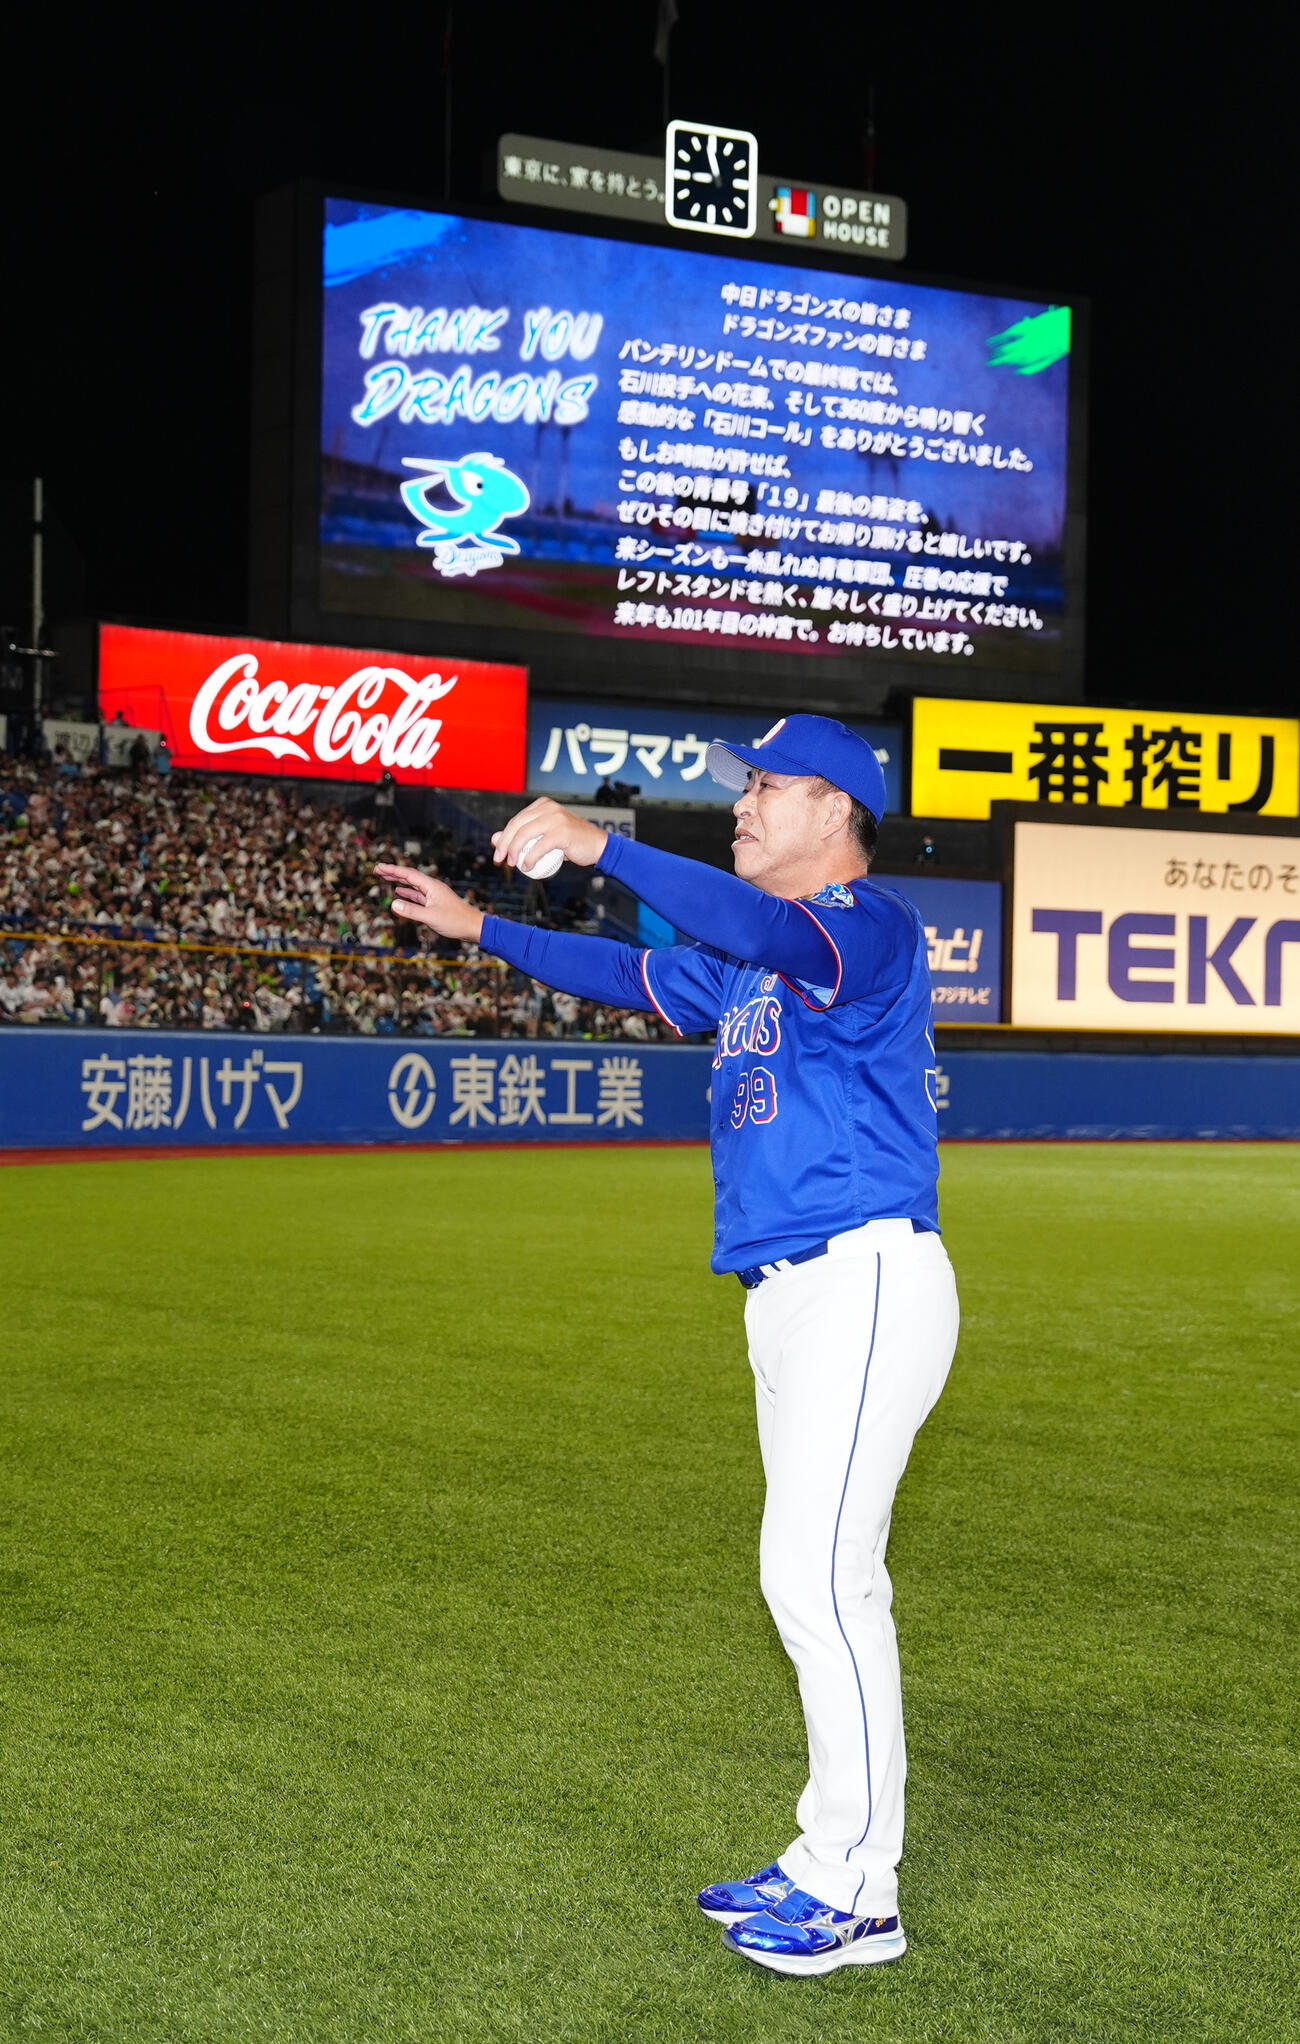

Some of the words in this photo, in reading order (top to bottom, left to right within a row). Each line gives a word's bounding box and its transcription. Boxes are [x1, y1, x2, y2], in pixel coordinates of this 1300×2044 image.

[503, 155, 665, 203] 東京に、家を持とう。
[823, 195, 891, 227] OPEN
[823, 220, 890, 248] HOUSE
[360, 303, 509, 359] THANK
[520, 306, 602, 361] YOU
[720, 282, 912, 330] 中日ドラゴンズの皆さま
[723, 313, 927, 361] ドラゴンズファンの皆さま
[352, 361, 598, 427] DRAGONS
[618, 338, 899, 396] バンテリンドームでの最終戦では、
[618, 436, 792, 479] もしお時間が許せば、
[190, 653, 458, 769] Coca-Cola
[939, 722, 1274, 813] 一番搾り
[82, 1049, 303, 1130] 安藤ハザマ
[449, 1053, 643, 1129] 東鉄工業
[731, 1066, 778, 1129] 99
